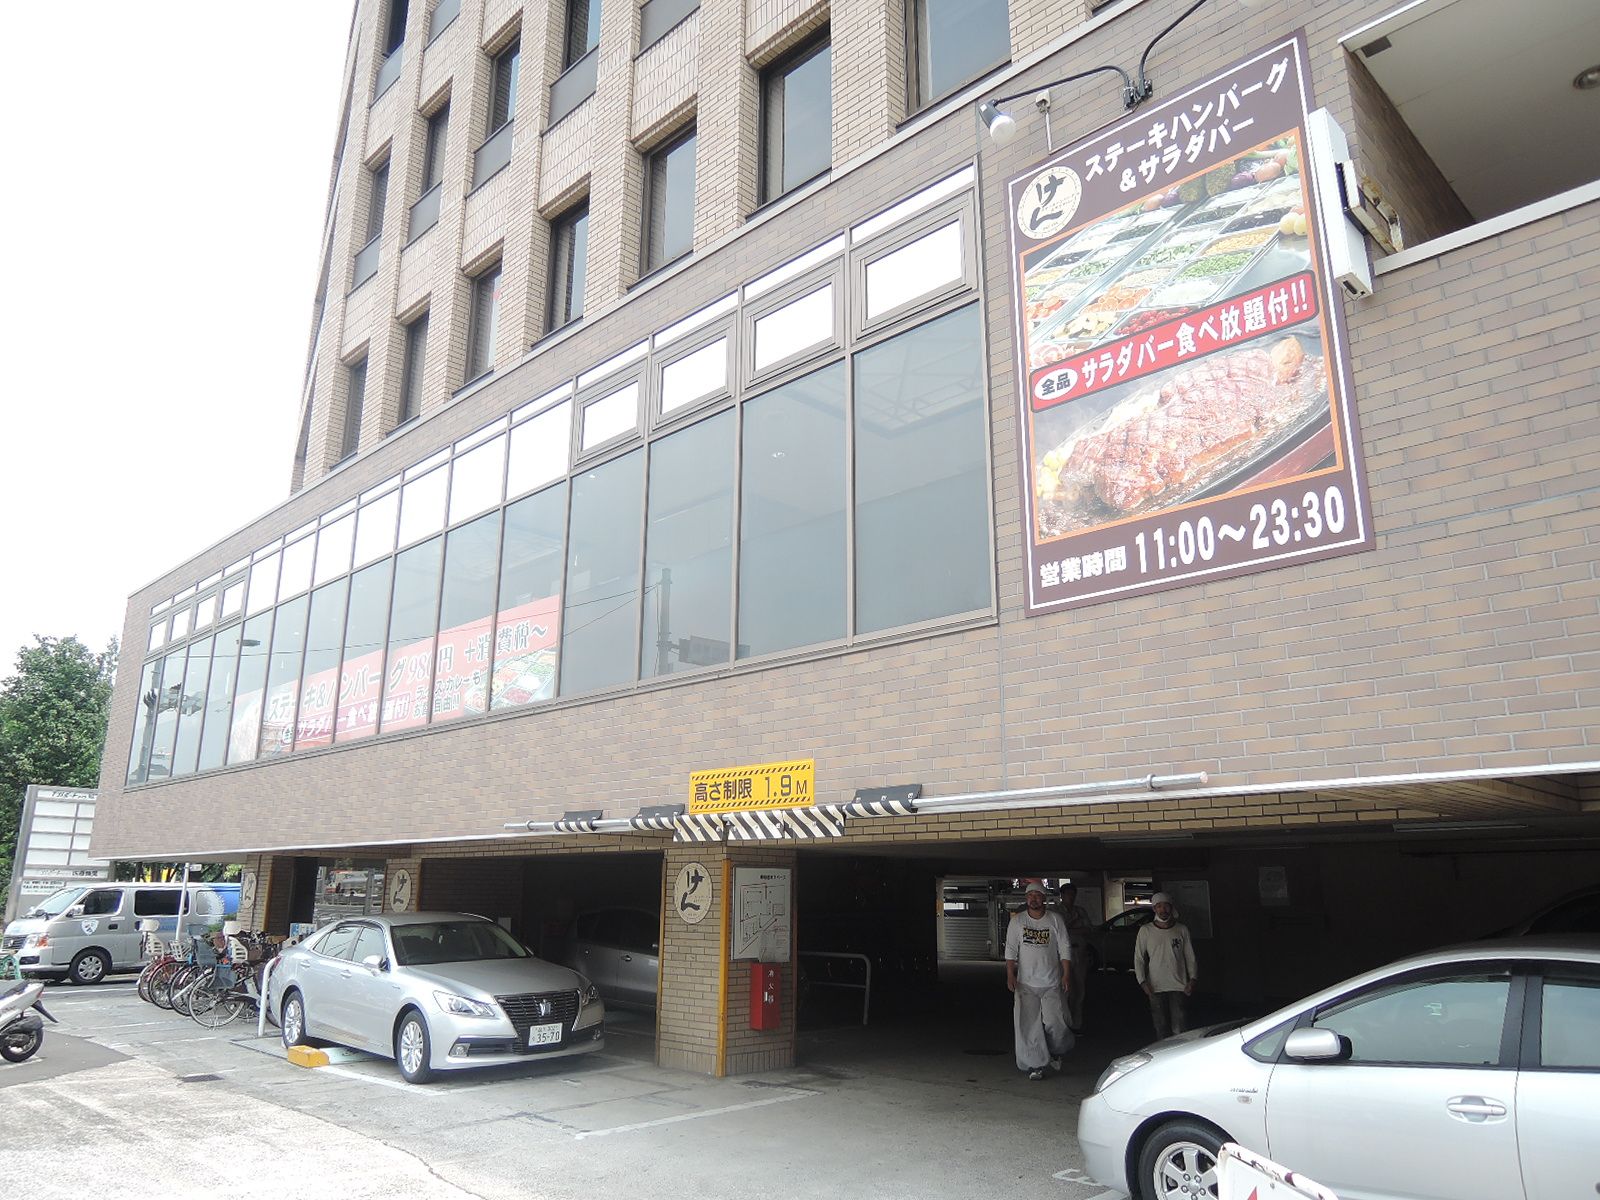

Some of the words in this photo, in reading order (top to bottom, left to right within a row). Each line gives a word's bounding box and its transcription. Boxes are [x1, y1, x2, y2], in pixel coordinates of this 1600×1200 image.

[1084, 57, 1289, 182] ステーキハンバーグ
[1118, 117, 1255, 192] &サラダバー
[1029, 174, 1067, 231] けん
[1081, 279, 1309, 388] サラダバー食べ放題付!!
[1040, 371, 1071, 396] 全品
[1039, 545, 1128, 588] 営業時間
[694, 778, 753, 803] 高さ制限
[681, 869, 705, 911] けん
